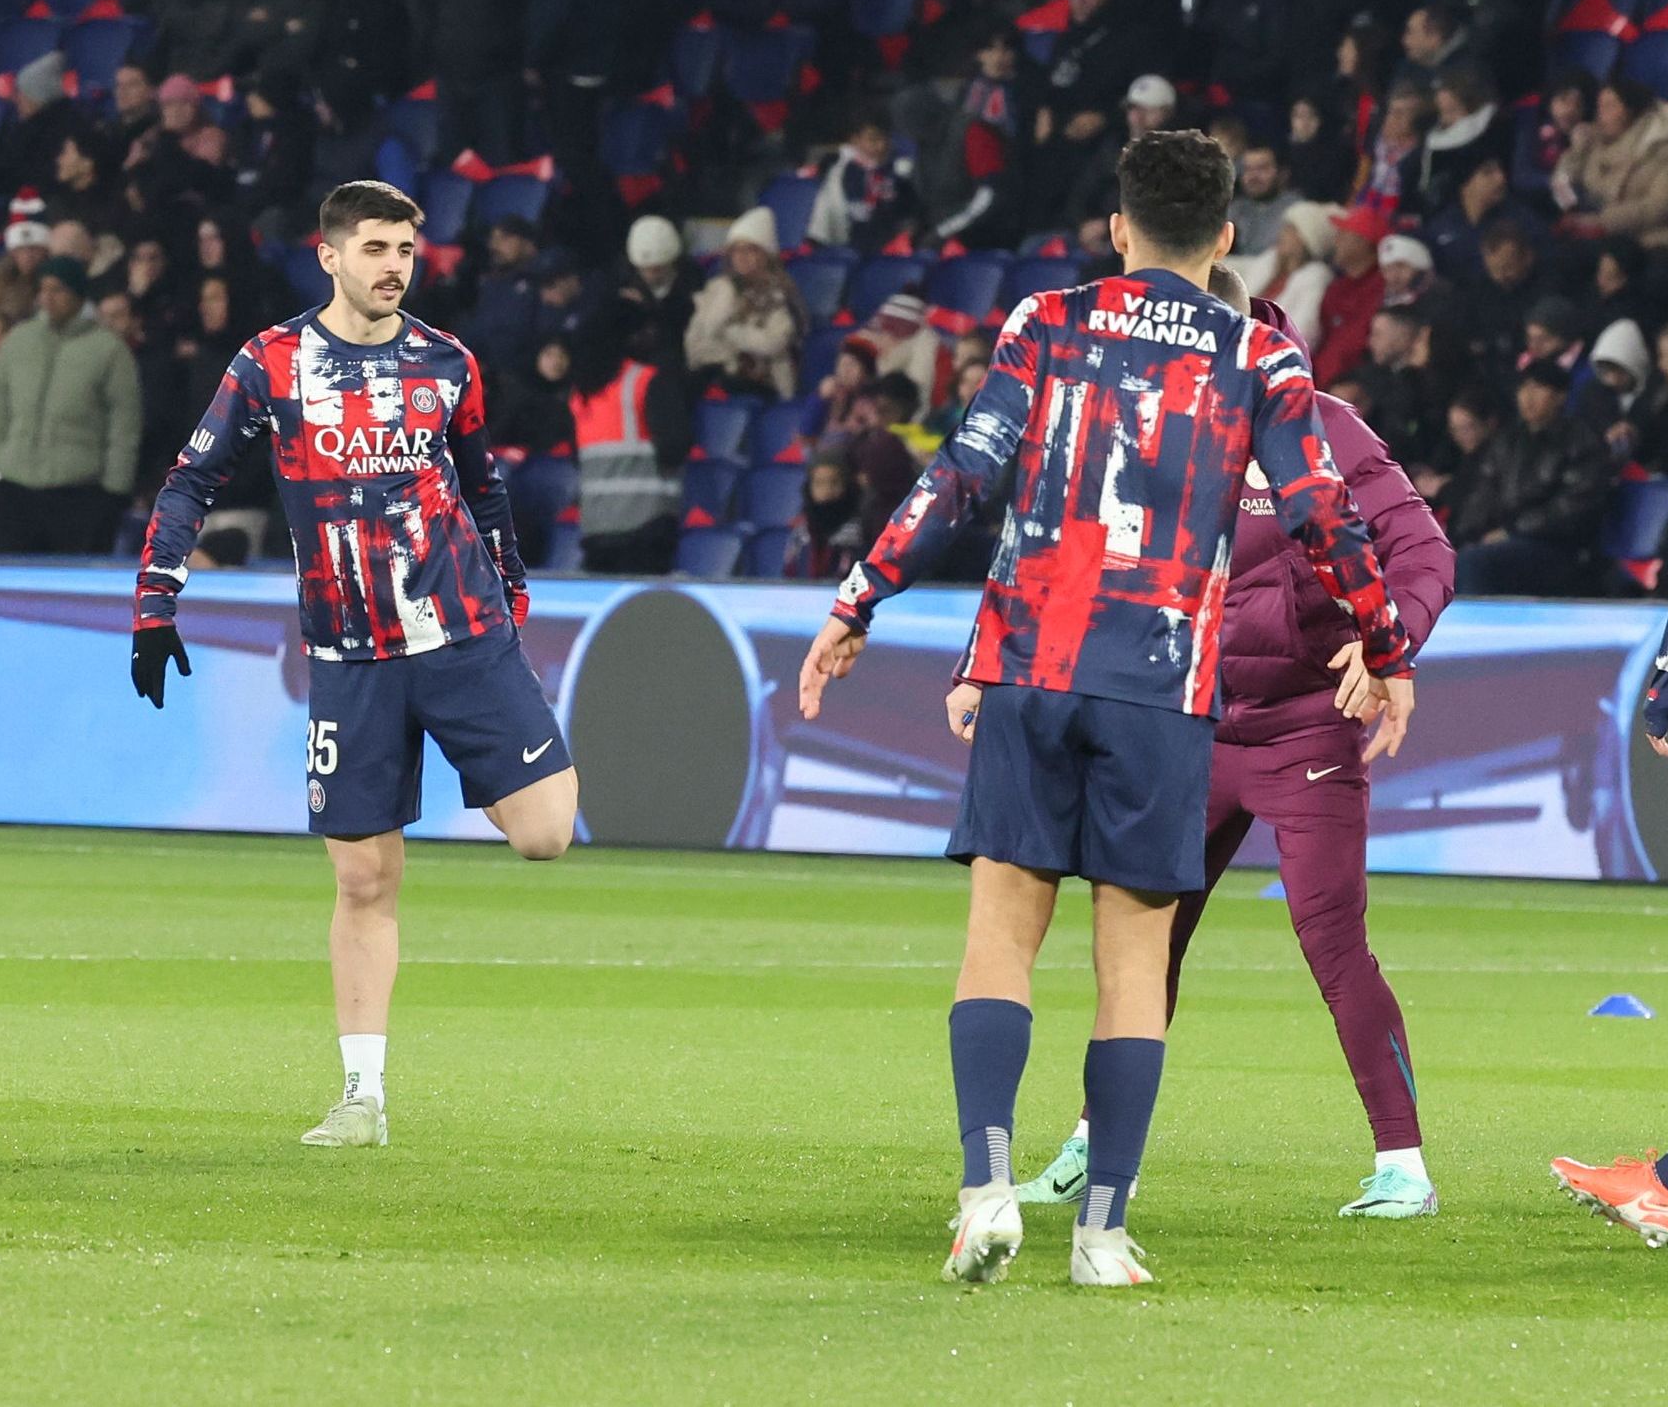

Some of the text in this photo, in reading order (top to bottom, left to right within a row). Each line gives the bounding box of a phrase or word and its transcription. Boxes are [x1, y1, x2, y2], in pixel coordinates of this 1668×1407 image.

[1123, 292, 1197, 324] VISIT
[1088, 310, 1217, 352] RWANDA
[314, 426, 433, 462] QATAR
[347, 454, 433, 474] AIRWAYS
[1239, 498, 1273, 511] QATA
